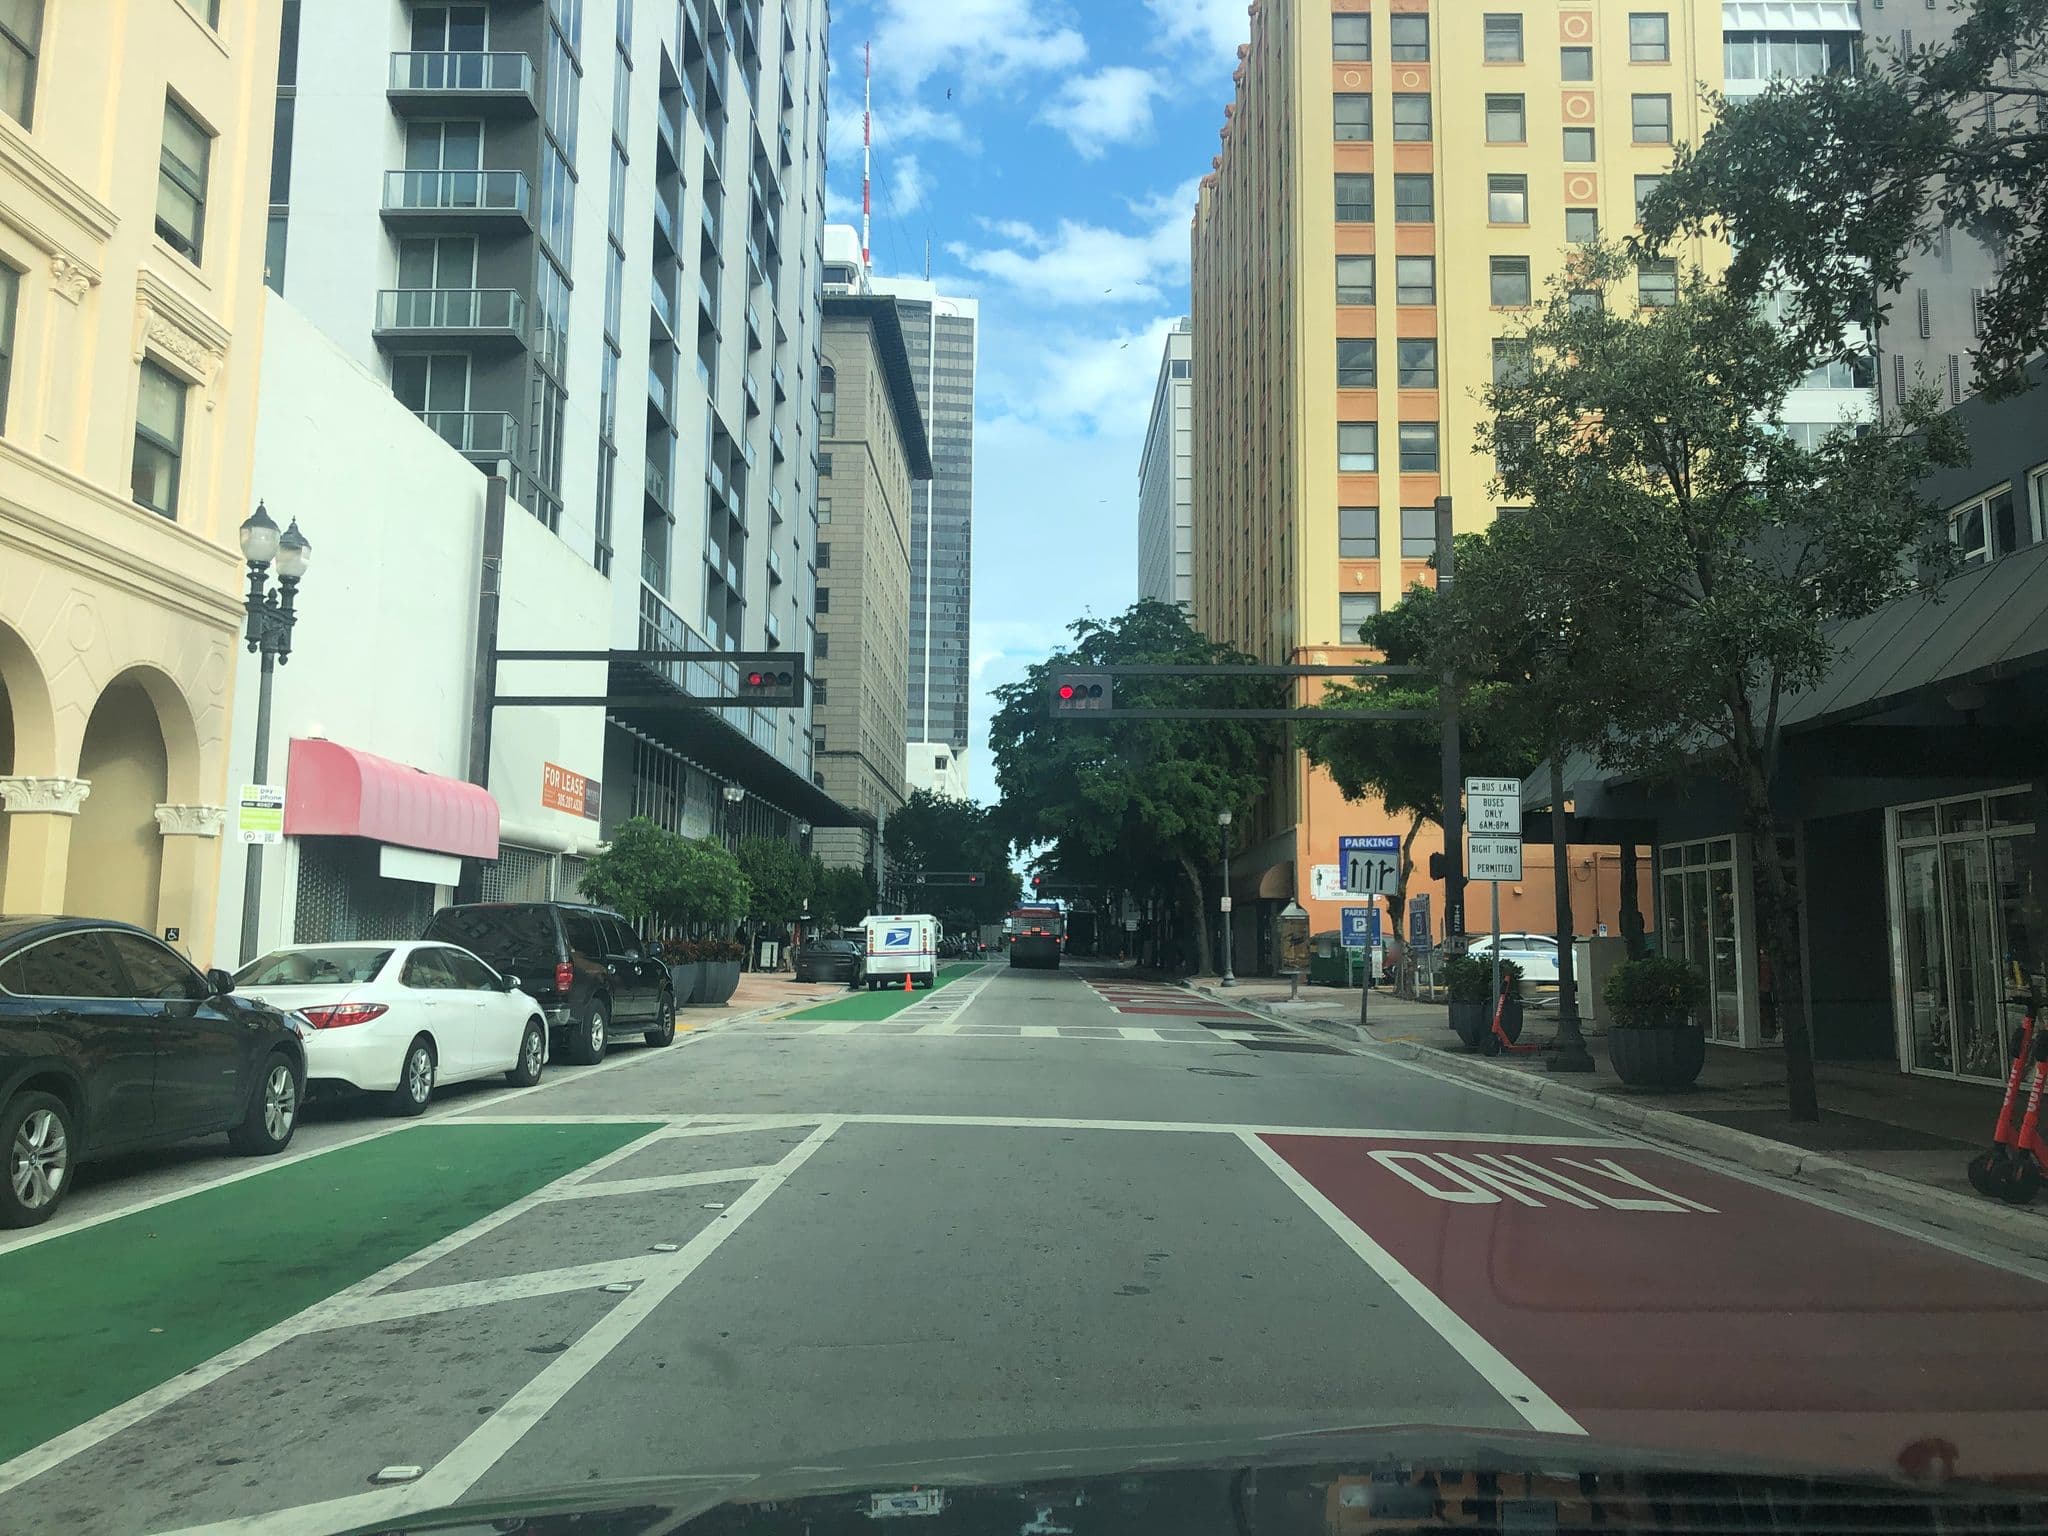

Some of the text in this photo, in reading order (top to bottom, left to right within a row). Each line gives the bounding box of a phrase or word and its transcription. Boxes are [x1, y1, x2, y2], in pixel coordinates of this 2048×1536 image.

[545, 766, 560, 788] FOR
[561, 773, 584, 797] LEASE
[1481, 783, 1516, 792] BUS LANE
[1483, 798, 1504, 807] BUSES
[1484, 809, 1502, 818] ONLY
[1345, 837, 1393, 848] PARKING
[1471, 845, 1518, 855] RIGHT TURNS
[1477, 863, 1513, 873] PERMITTED
[1344, 909, 1377, 917] PARKIG
[1366, 1150, 1722, 1213] ONLY
